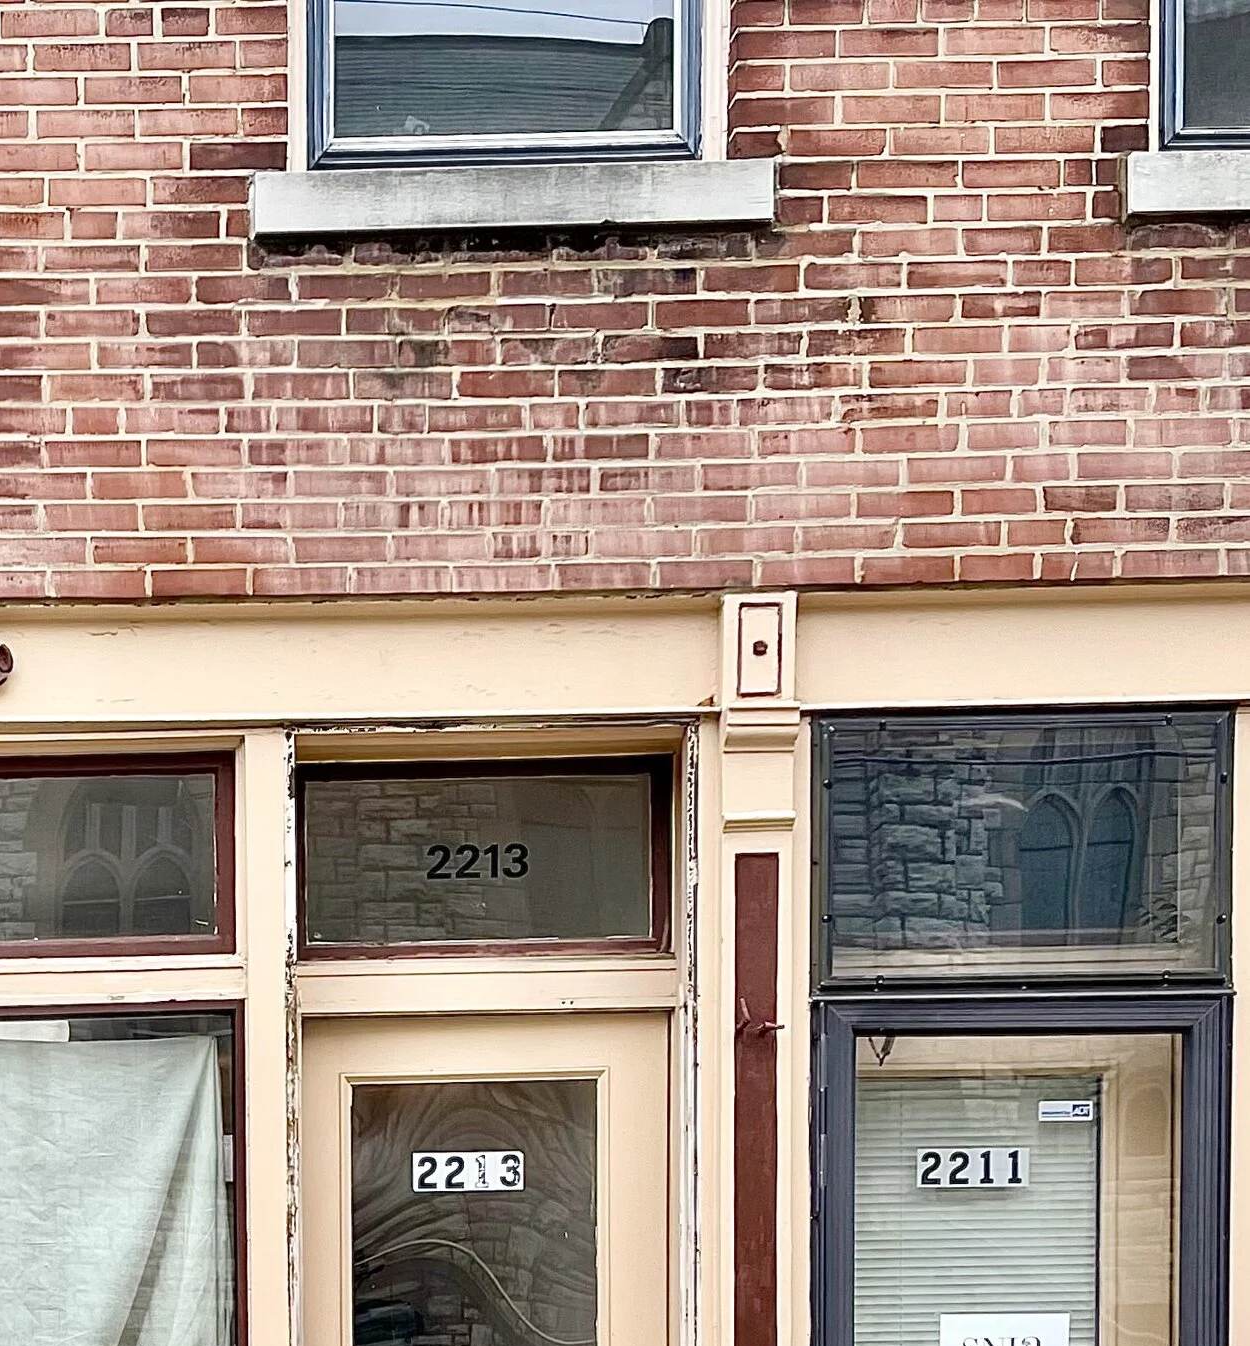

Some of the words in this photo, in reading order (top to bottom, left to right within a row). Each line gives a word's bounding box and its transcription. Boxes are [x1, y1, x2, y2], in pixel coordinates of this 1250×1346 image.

[426, 843, 529, 880] 2213
[417, 1154, 521, 1189] 2213
[920, 1150, 1023, 1185] 2211
